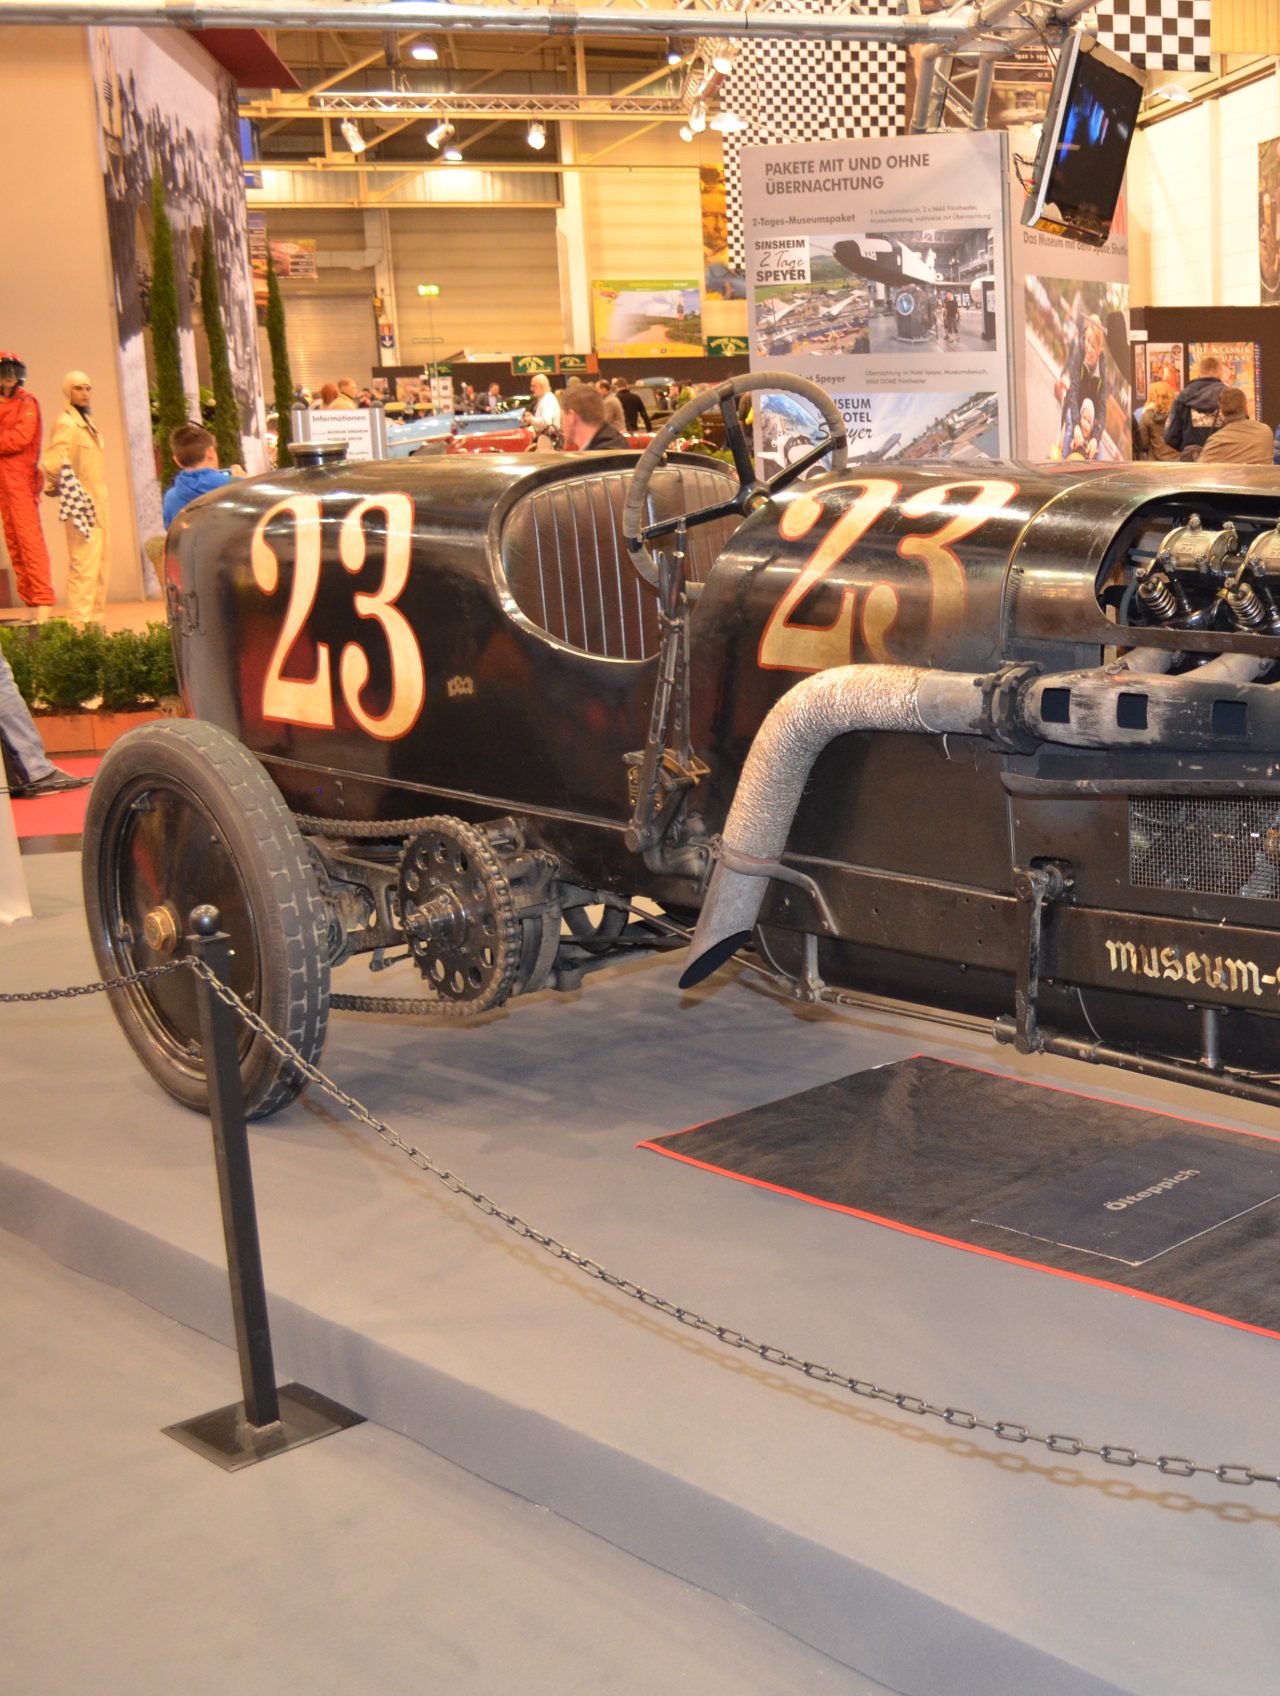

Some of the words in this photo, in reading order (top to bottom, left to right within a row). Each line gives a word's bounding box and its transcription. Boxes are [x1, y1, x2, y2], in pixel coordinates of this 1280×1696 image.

[765, 161, 815, 176] PAKETE
[819, 159, 844, 173] MIT
[849, 156, 882, 171] UND
[886, 154, 930, 169] OHNE
[766, 176, 884, 195] ÜBERNACHTUNG
[752, 214, 855, 228] 2-Tages-Museumspaket
[754, 239, 805, 250] SINSHEIM
[759, 251, 771, 268] 2
[756, 269, 806, 282] SPEYER
[816, 374, 846, 385] Speyer
[834, 398, 872, 409] SEUM
[842, 412, 872, 423] OTEL
[757, 478, 1020, 673] 23
[251, 491, 426, 742] 23
[1104, 1168, 1201, 1211] Ölteppich
